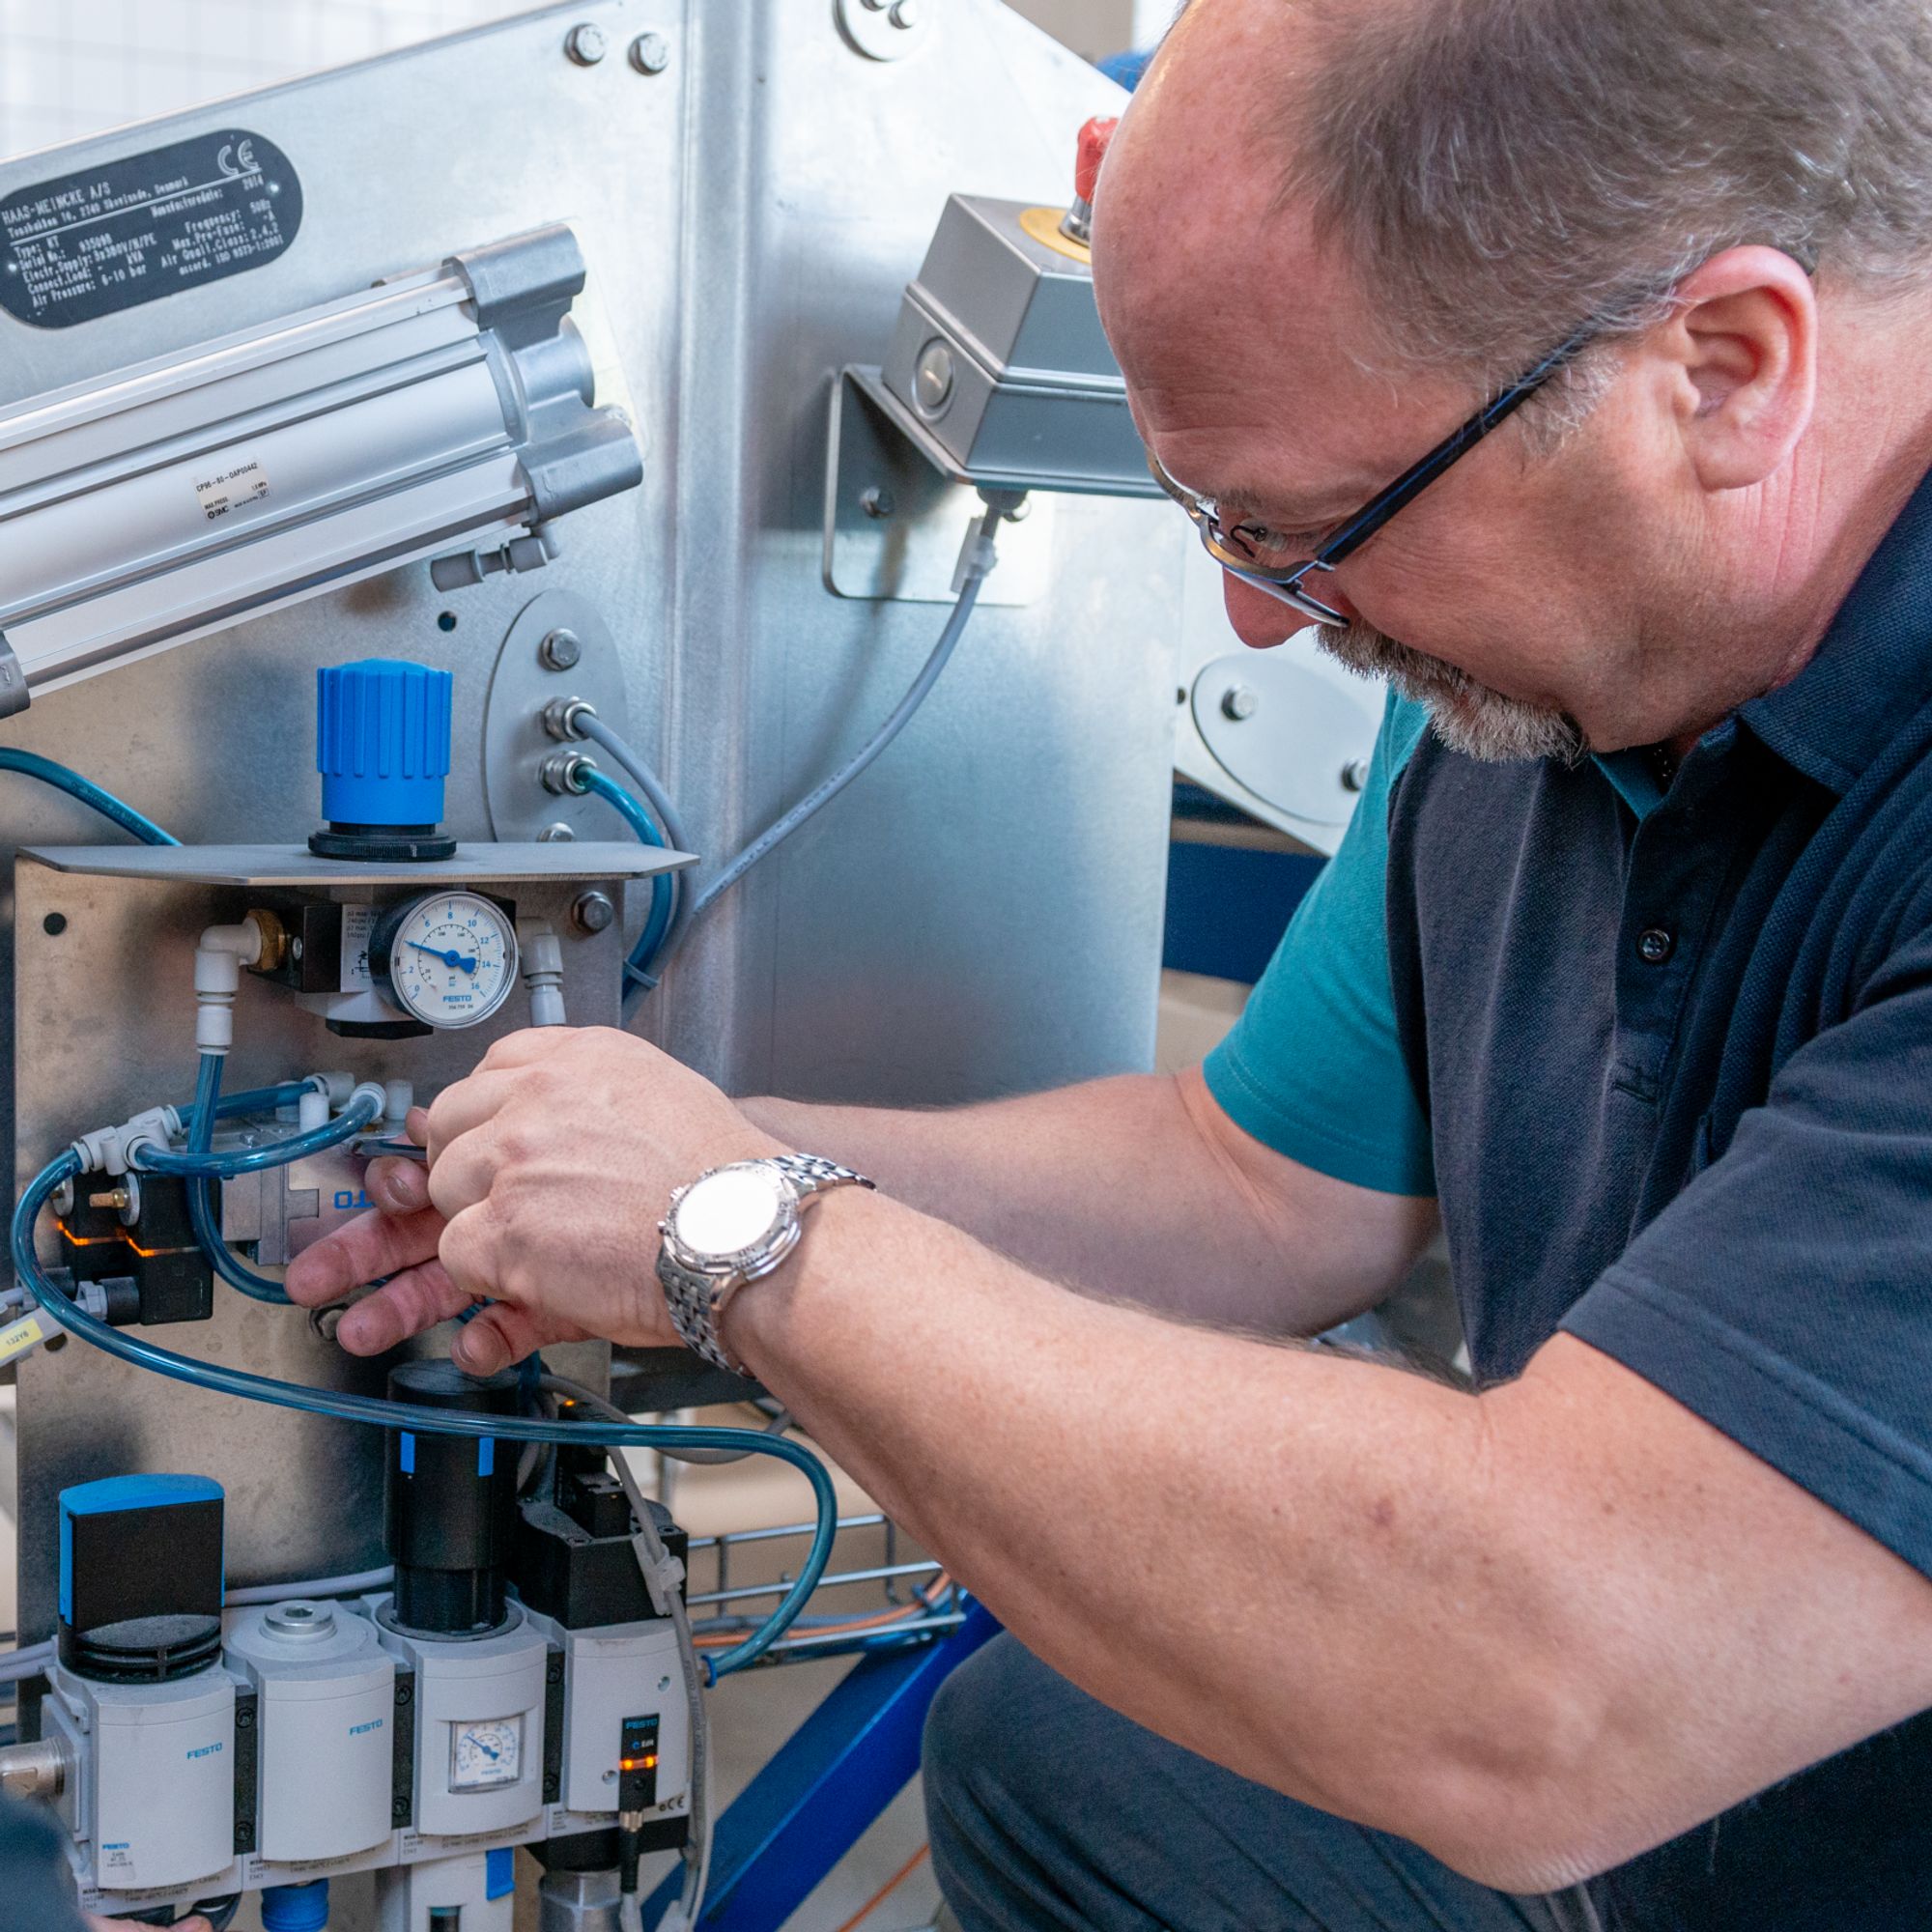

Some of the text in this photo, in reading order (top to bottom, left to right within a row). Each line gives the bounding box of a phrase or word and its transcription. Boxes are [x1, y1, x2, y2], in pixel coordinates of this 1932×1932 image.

[1, 182, 111, 225] HAAS-MEINCKE A/S
[185, 209, 242, 234] Frequency:
[160, 254, 178, 269] Air
[32, 295, 47, 307] Air
[51, 280, 96, 302] Pressure:
[128, 264, 147, 277] bar
[214, 504, 229, 517] SMC
[350, 1719, 383, 1736] FESTO
[626, 1719, 657, 1729] FESTO
[186, 1742, 222, 1759] FESTO
[668, 1795, 684, 1810] CE
